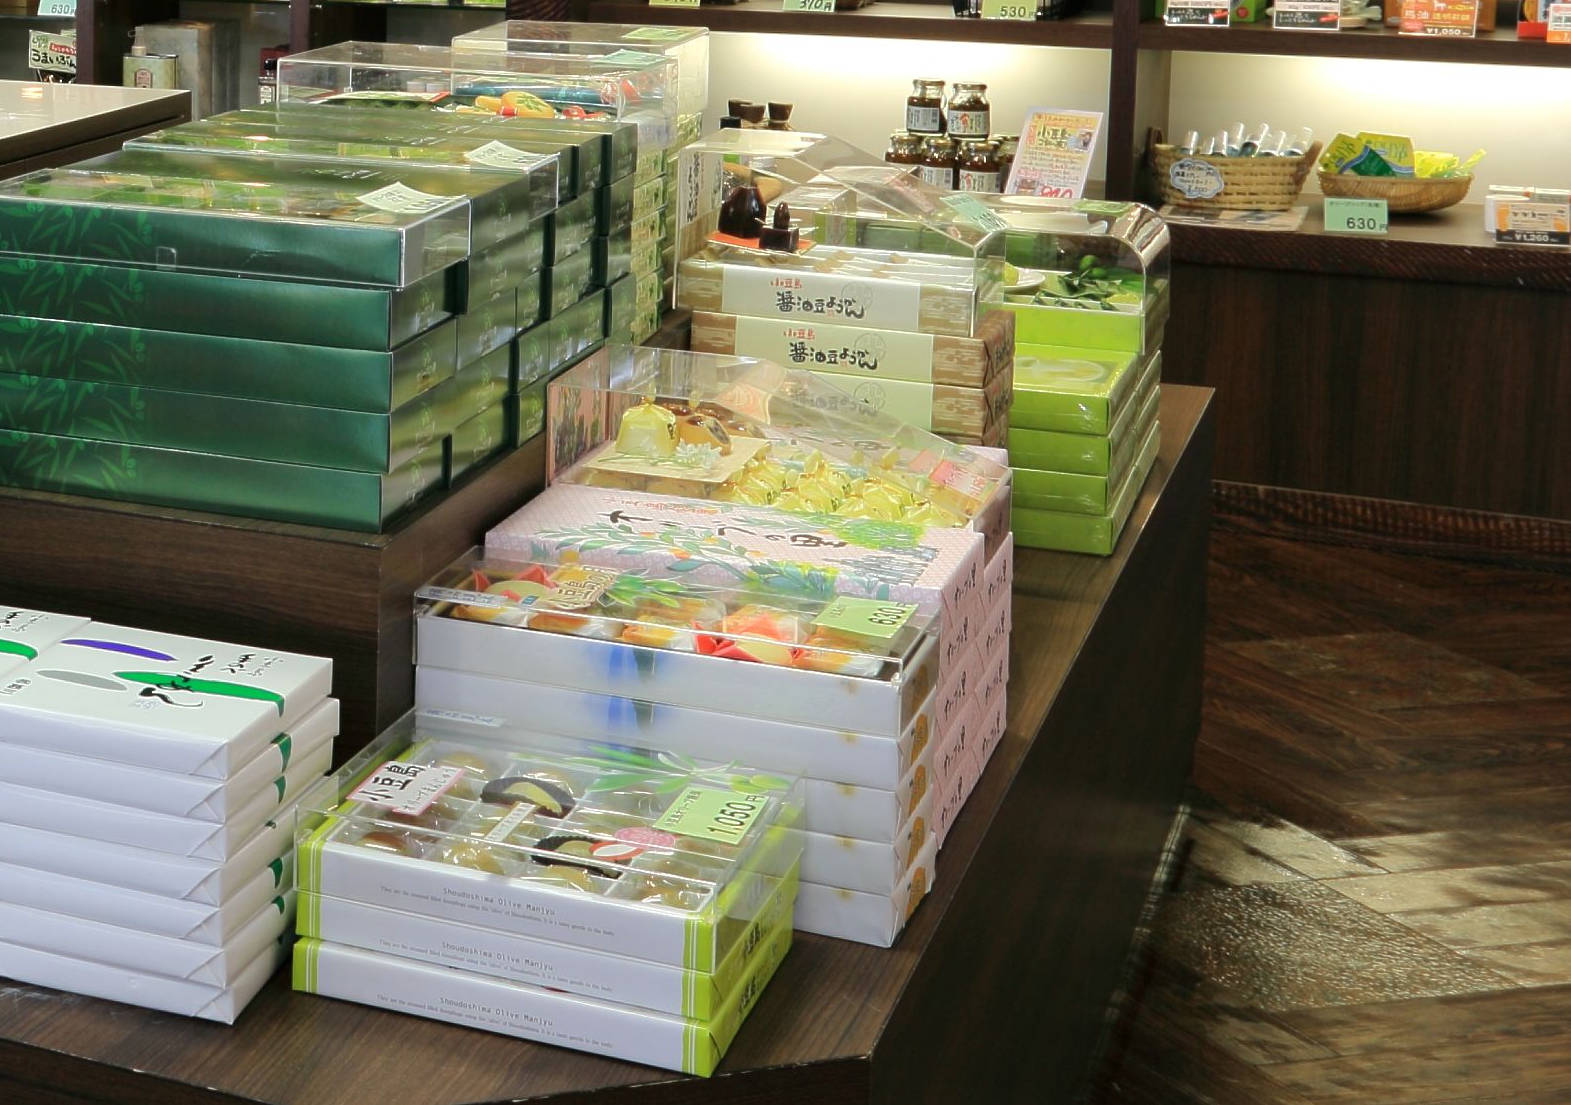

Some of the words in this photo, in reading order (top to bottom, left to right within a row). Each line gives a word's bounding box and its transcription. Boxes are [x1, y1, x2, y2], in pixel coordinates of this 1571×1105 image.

[771, 278, 802, 290] 小豆島
[775, 289, 866, 320] 醤油豆ようかん
[783, 328, 816, 341] 小豆島
[789, 341, 879, 371] 醤油豆ようかん
[358, 764, 426, 802] 小豆島
[443, 887, 494, 904] Shoudoshima
[498, 898, 521, 910] Olive
[526, 903, 556, 916] Manjyu
[442, 941, 493, 959] Shoudoshima
[497, 952, 521, 965] Olive
[524, 958, 555, 972] Manjyu
[440, 996, 492, 1014] Shoudoshima
[495, 1007, 520, 1021] Olive
[523, 1014, 554, 1027] Manjyu
